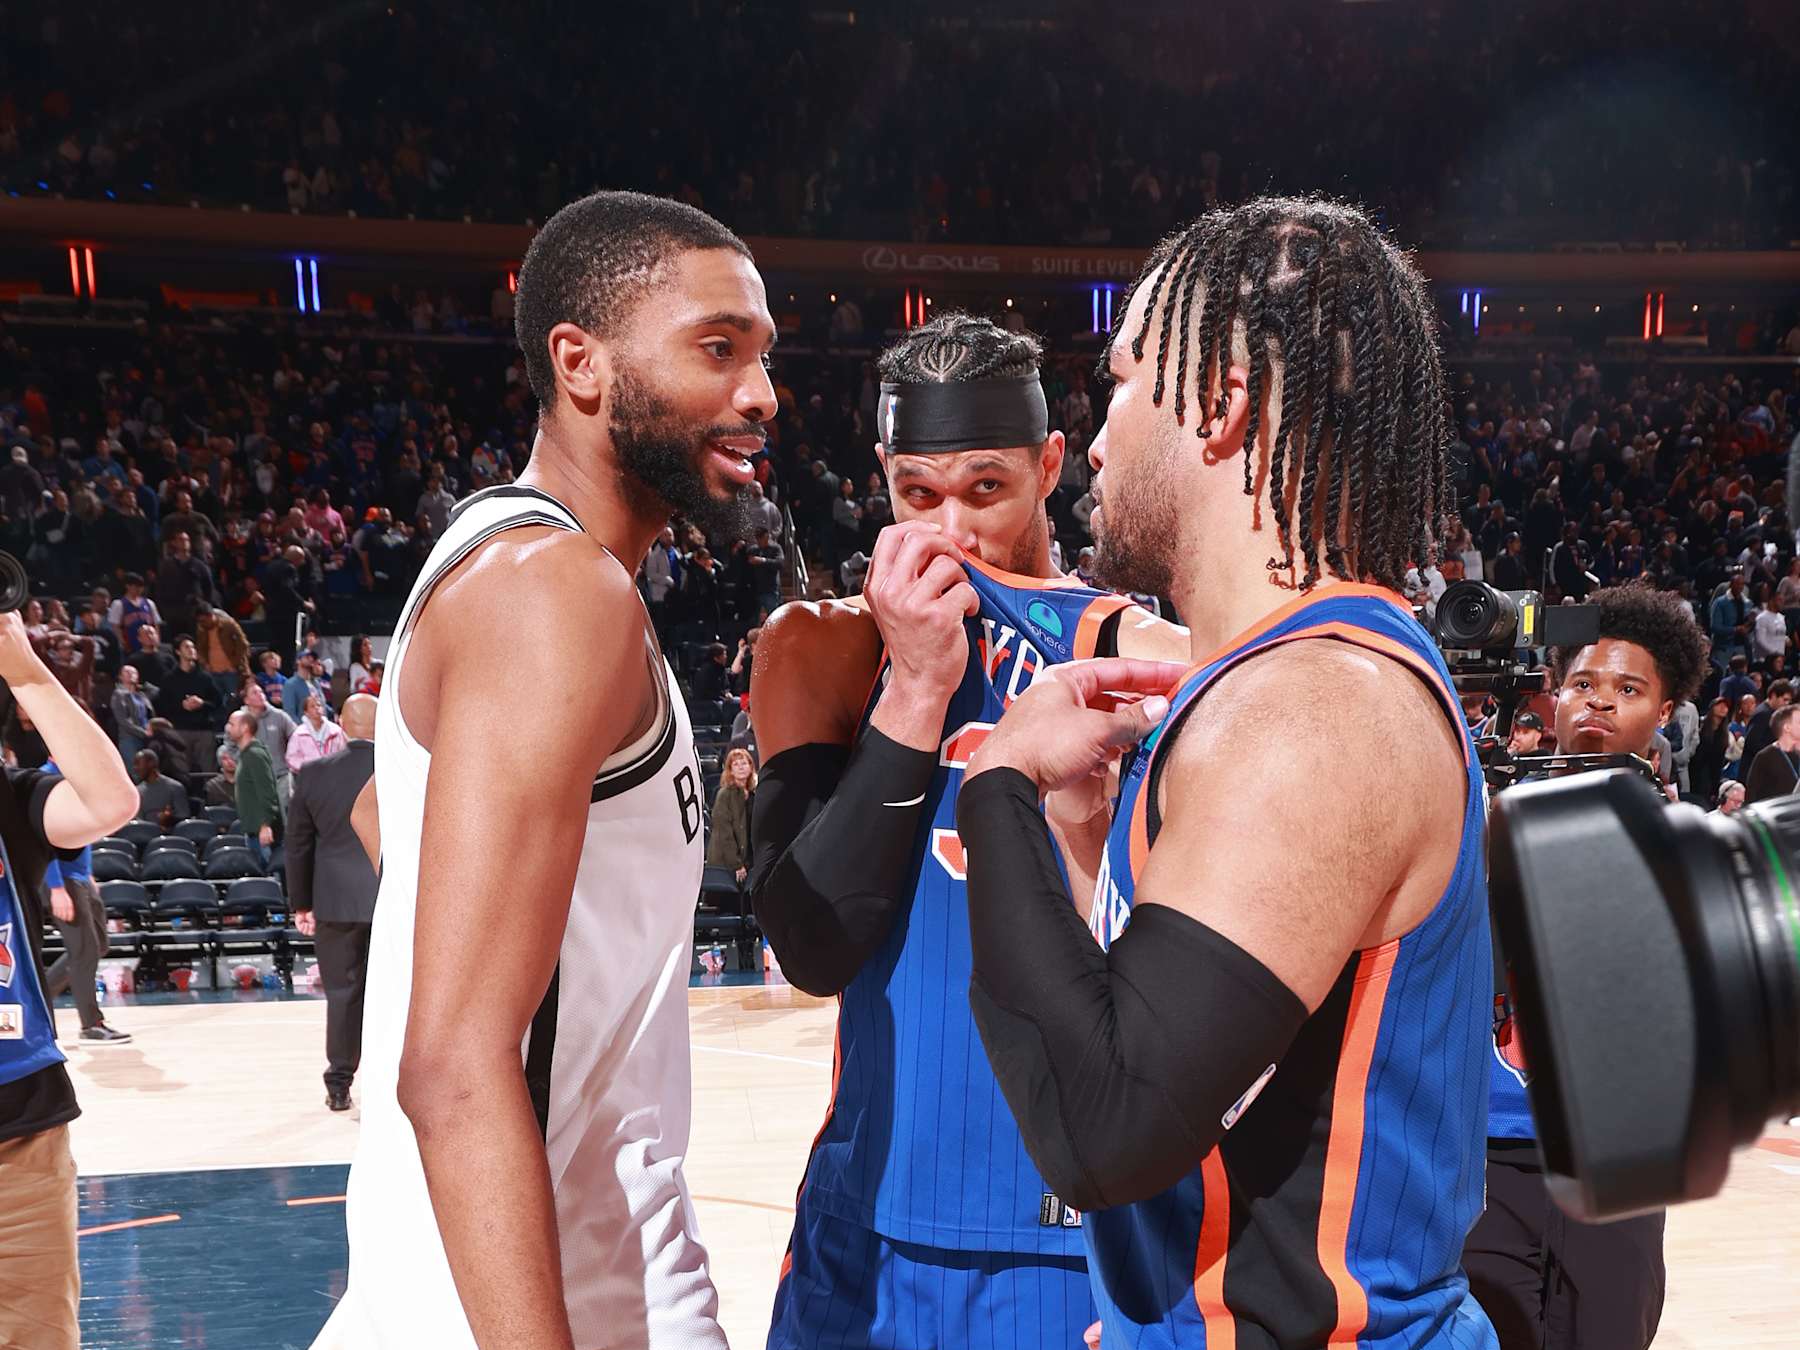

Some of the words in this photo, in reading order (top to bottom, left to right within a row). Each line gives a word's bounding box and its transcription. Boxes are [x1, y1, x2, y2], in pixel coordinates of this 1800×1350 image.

[900, 252, 1000, 271] LEXUS
[1031, 257, 1081, 274] SUITE
[1087, 258, 1136, 275] LEVEL
[979, 617, 1044, 707] YO
[673, 763, 703, 845] B
